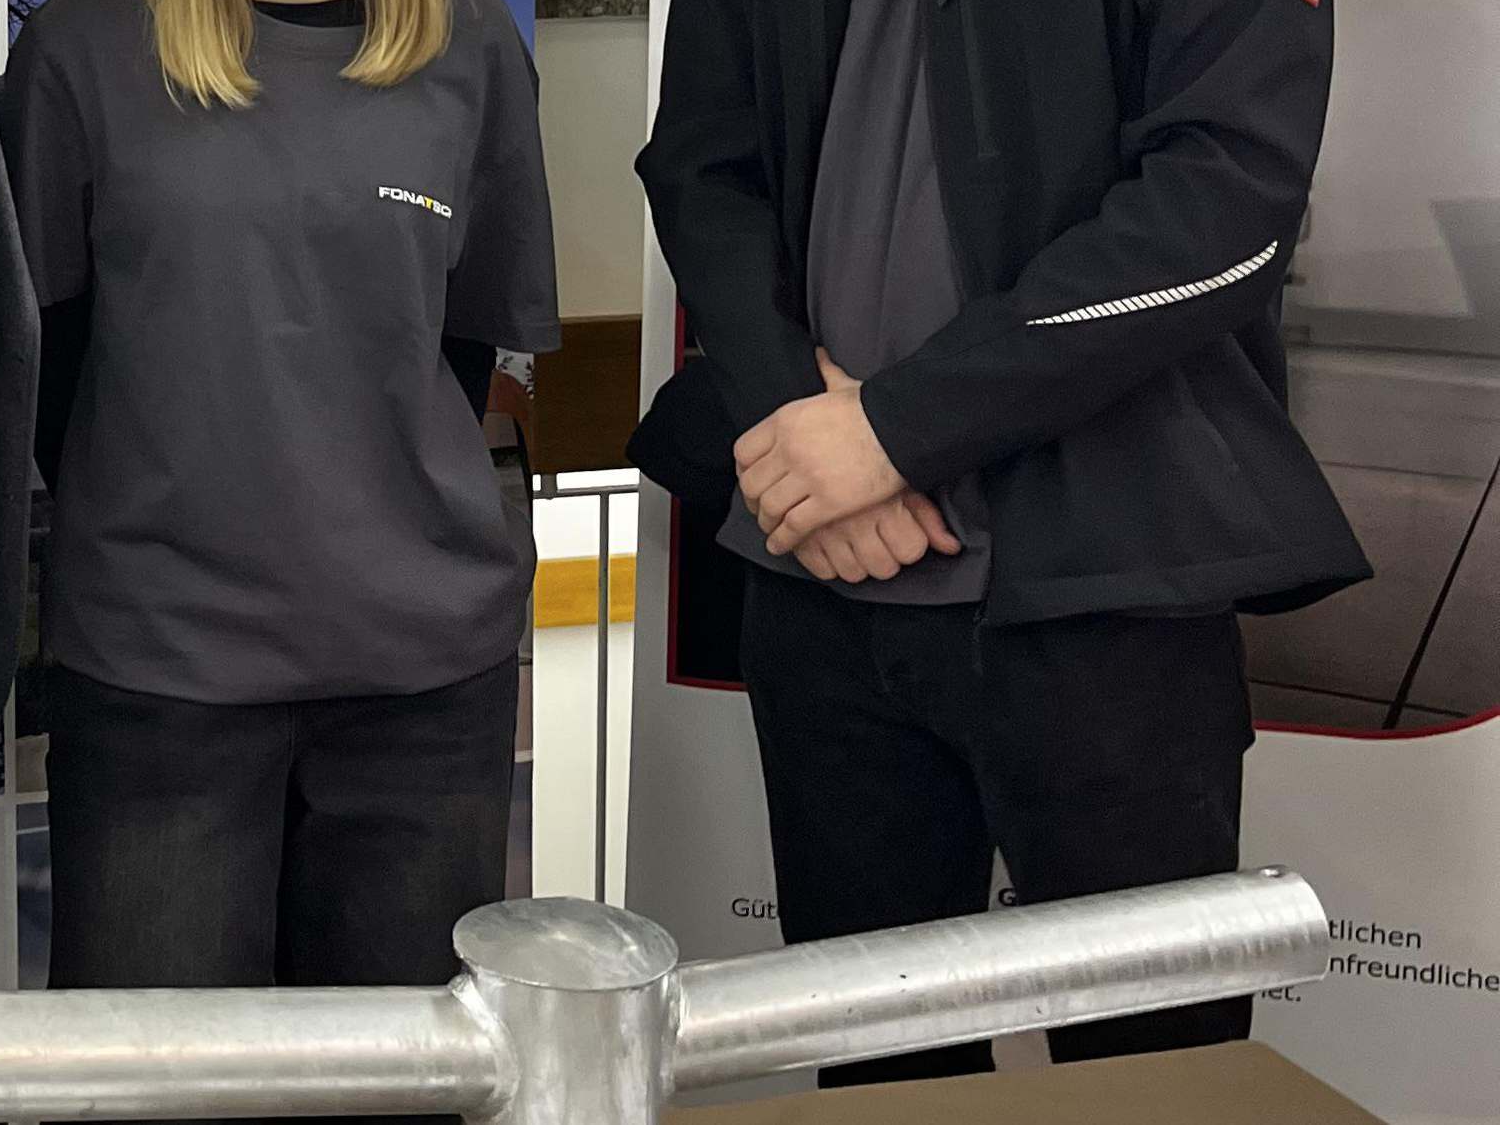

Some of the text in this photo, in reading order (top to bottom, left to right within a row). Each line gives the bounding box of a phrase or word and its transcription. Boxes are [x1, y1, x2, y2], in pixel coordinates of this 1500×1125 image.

[731, 897, 777, 920] Güt
[1328, 919, 1422, 949] tlichen
[1329, 953, 1500, 992] nfreundliche
